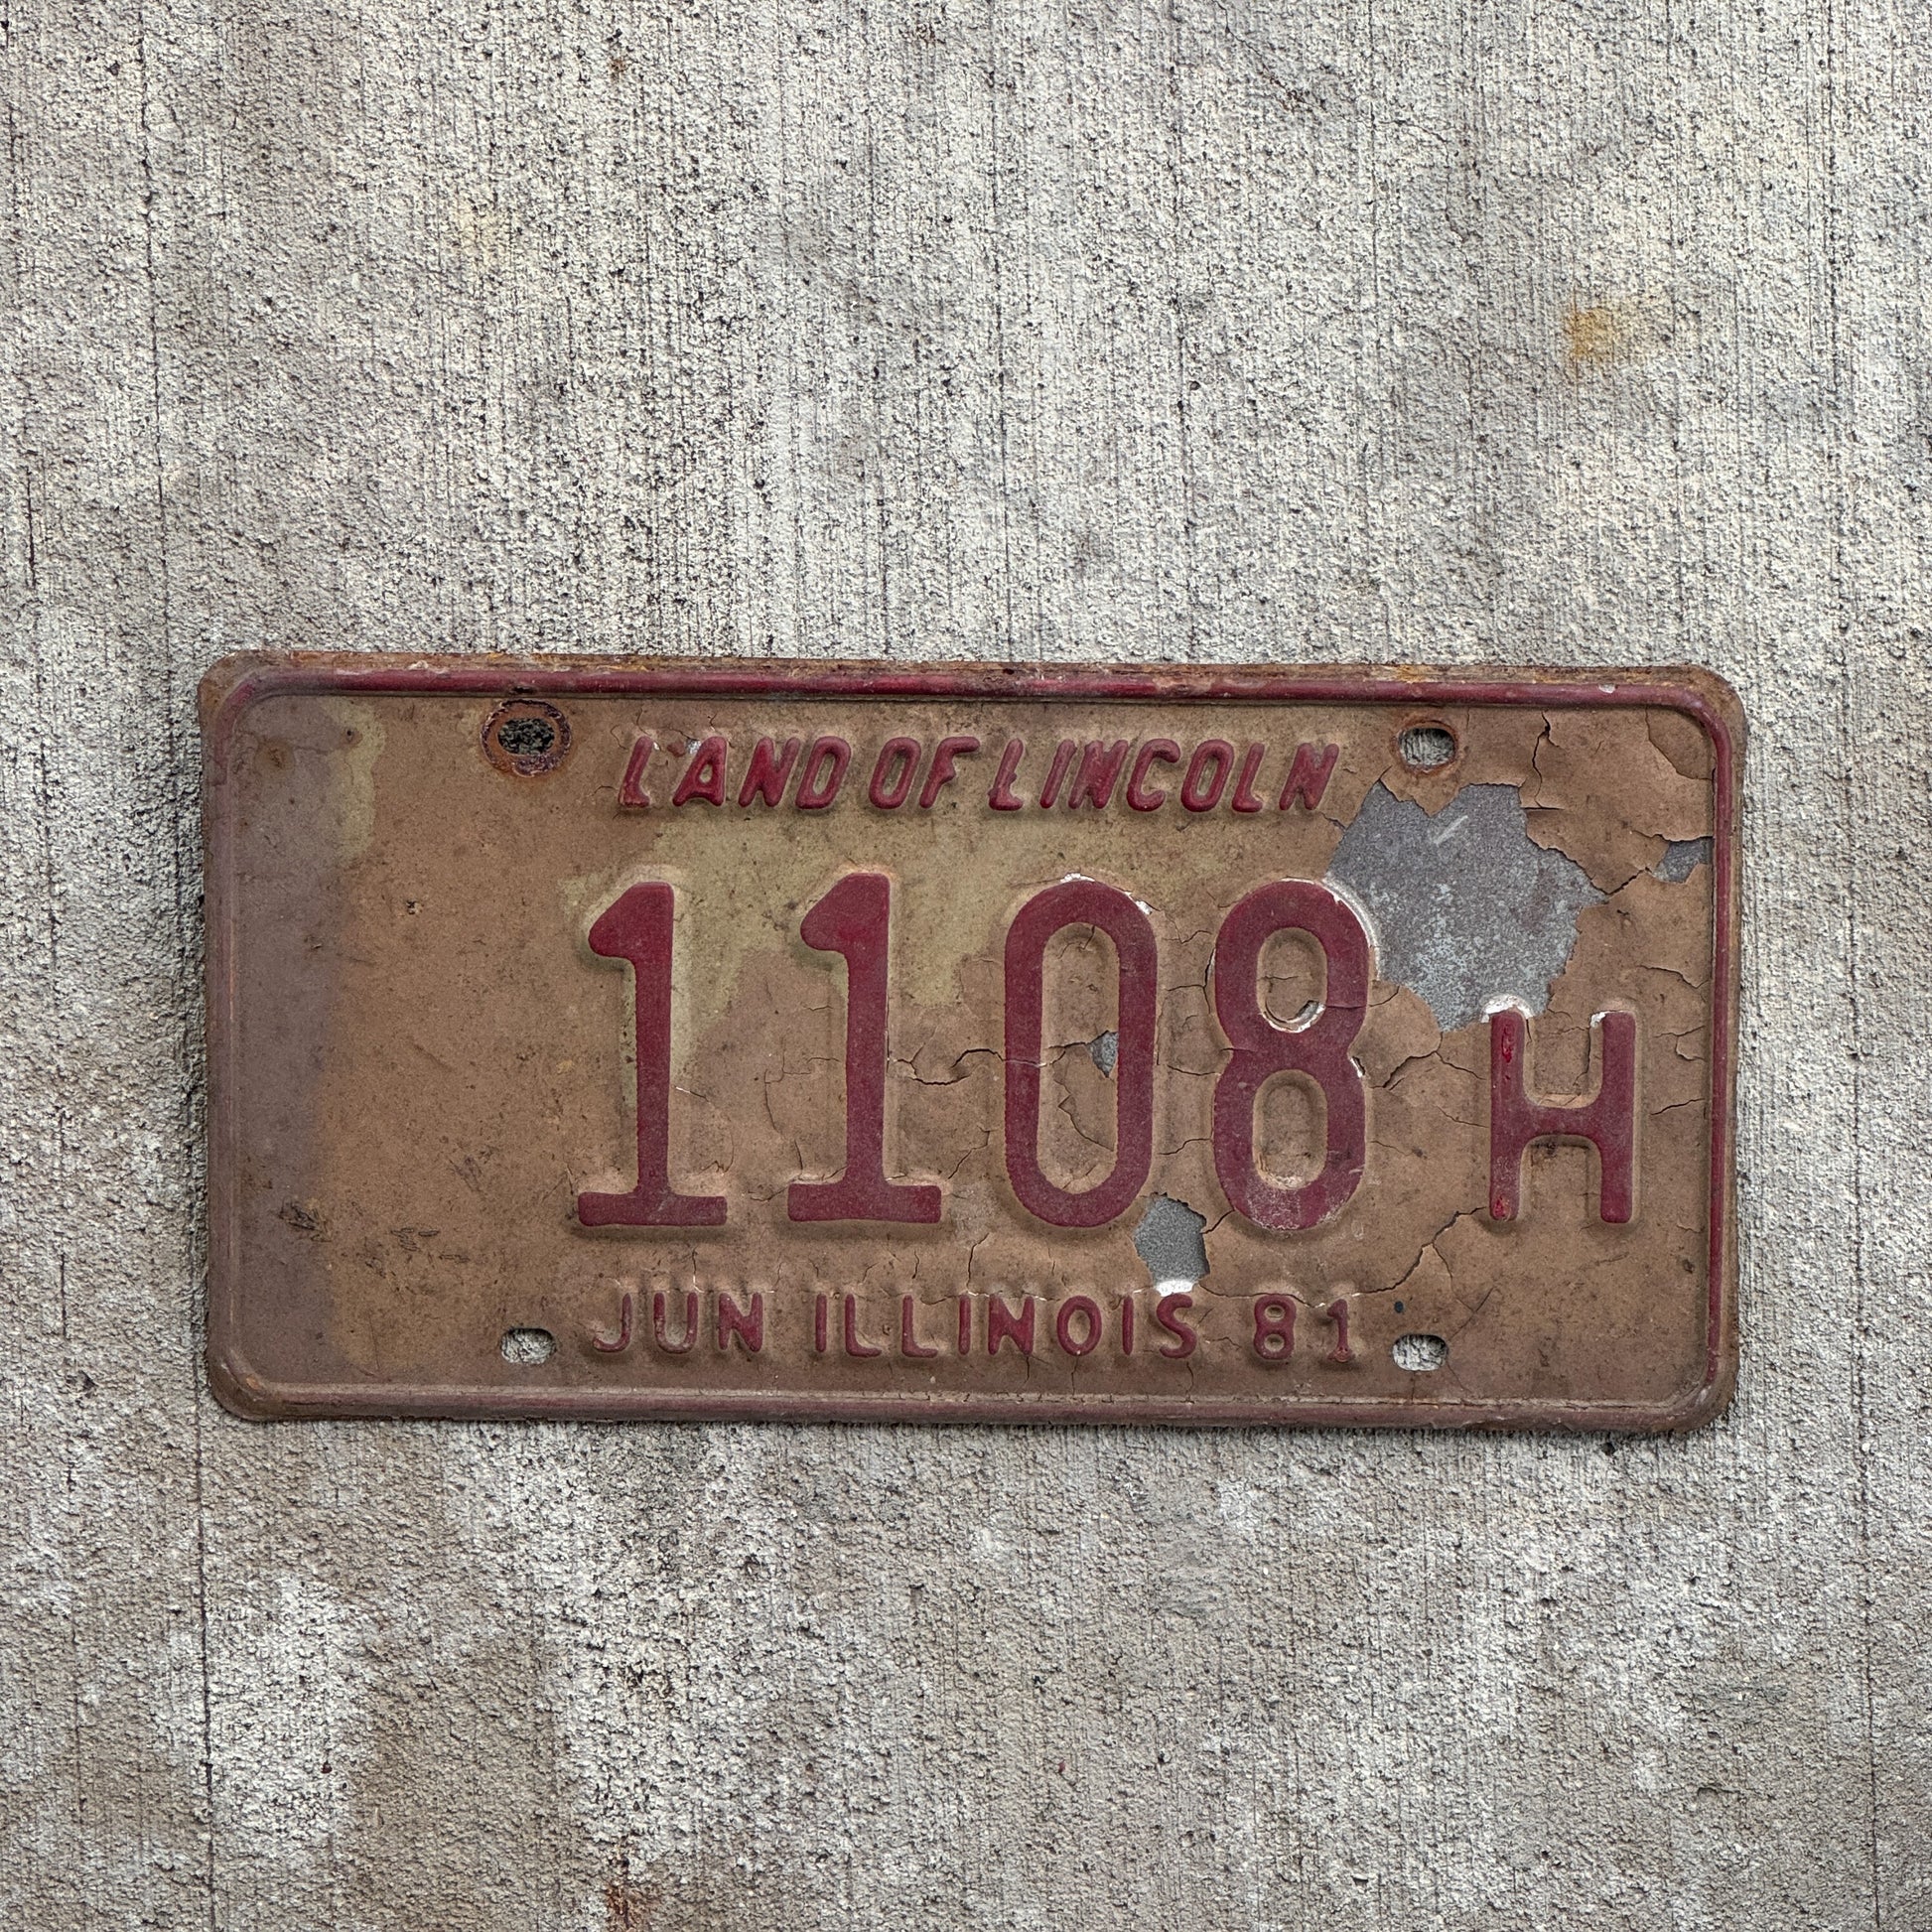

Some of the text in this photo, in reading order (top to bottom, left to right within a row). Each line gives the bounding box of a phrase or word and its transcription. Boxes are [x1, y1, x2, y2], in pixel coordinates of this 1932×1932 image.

[619, 736, 1340, 812] LAND OF LINCOLN
[578, 873, 1636, 1231] 1108 H
[594, 1292, 1364, 1363] JUN ILLINOIS 81
